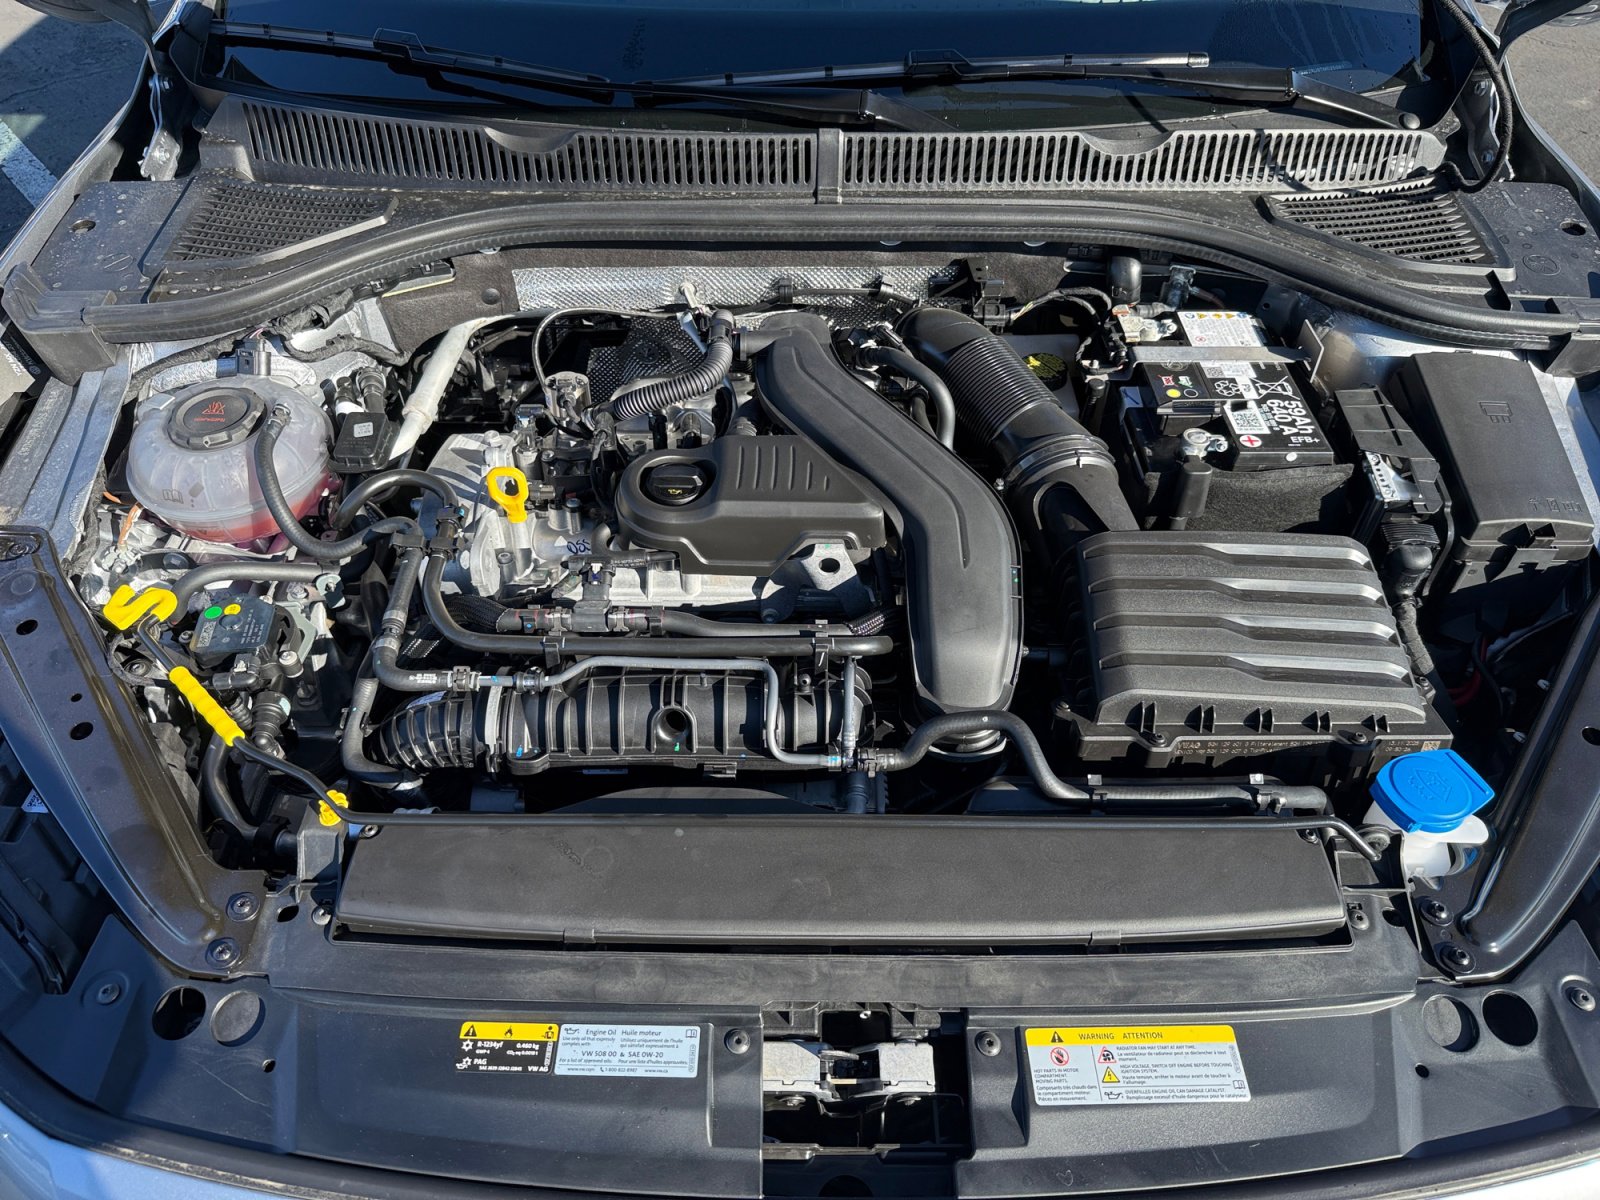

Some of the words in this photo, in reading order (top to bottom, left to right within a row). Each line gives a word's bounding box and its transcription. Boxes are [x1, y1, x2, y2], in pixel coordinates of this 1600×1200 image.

[1266, 400, 1292, 422] 640
[1279, 425, 1298, 435] A
[1284, 400, 1315, 434] 59Ah
